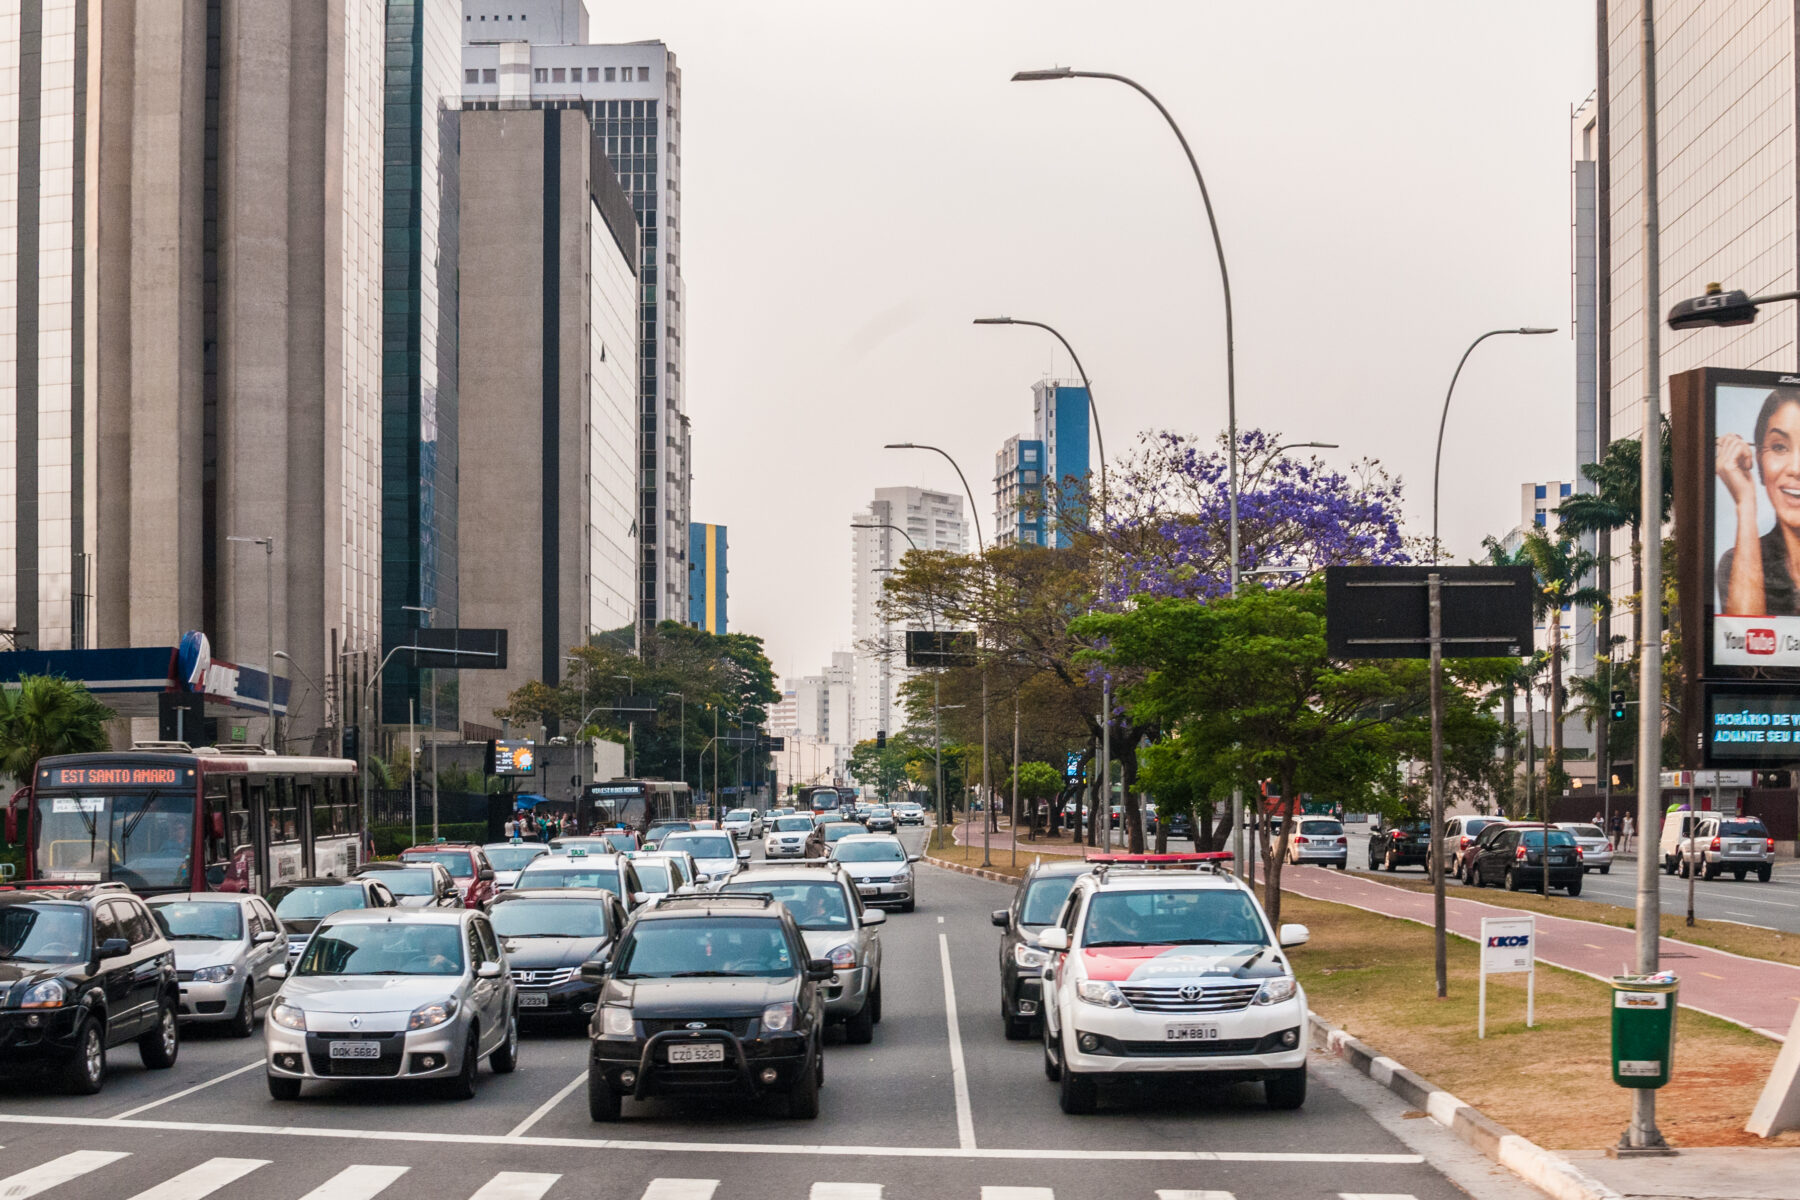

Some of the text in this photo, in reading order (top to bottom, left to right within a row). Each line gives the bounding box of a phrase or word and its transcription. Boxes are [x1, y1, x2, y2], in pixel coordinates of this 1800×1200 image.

[1714, 709, 1771, 726] HORÁRIO
[1772, 714, 1790, 726] DE
[1714, 730, 1766, 742] ADIANTE
[1766, 730, 1791, 742] SEU
[60, 769, 176, 784] EST SANTO AMARO
[571, 848, 585, 857] TAXI
[1487, 934, 1530, 948] KIKOS
